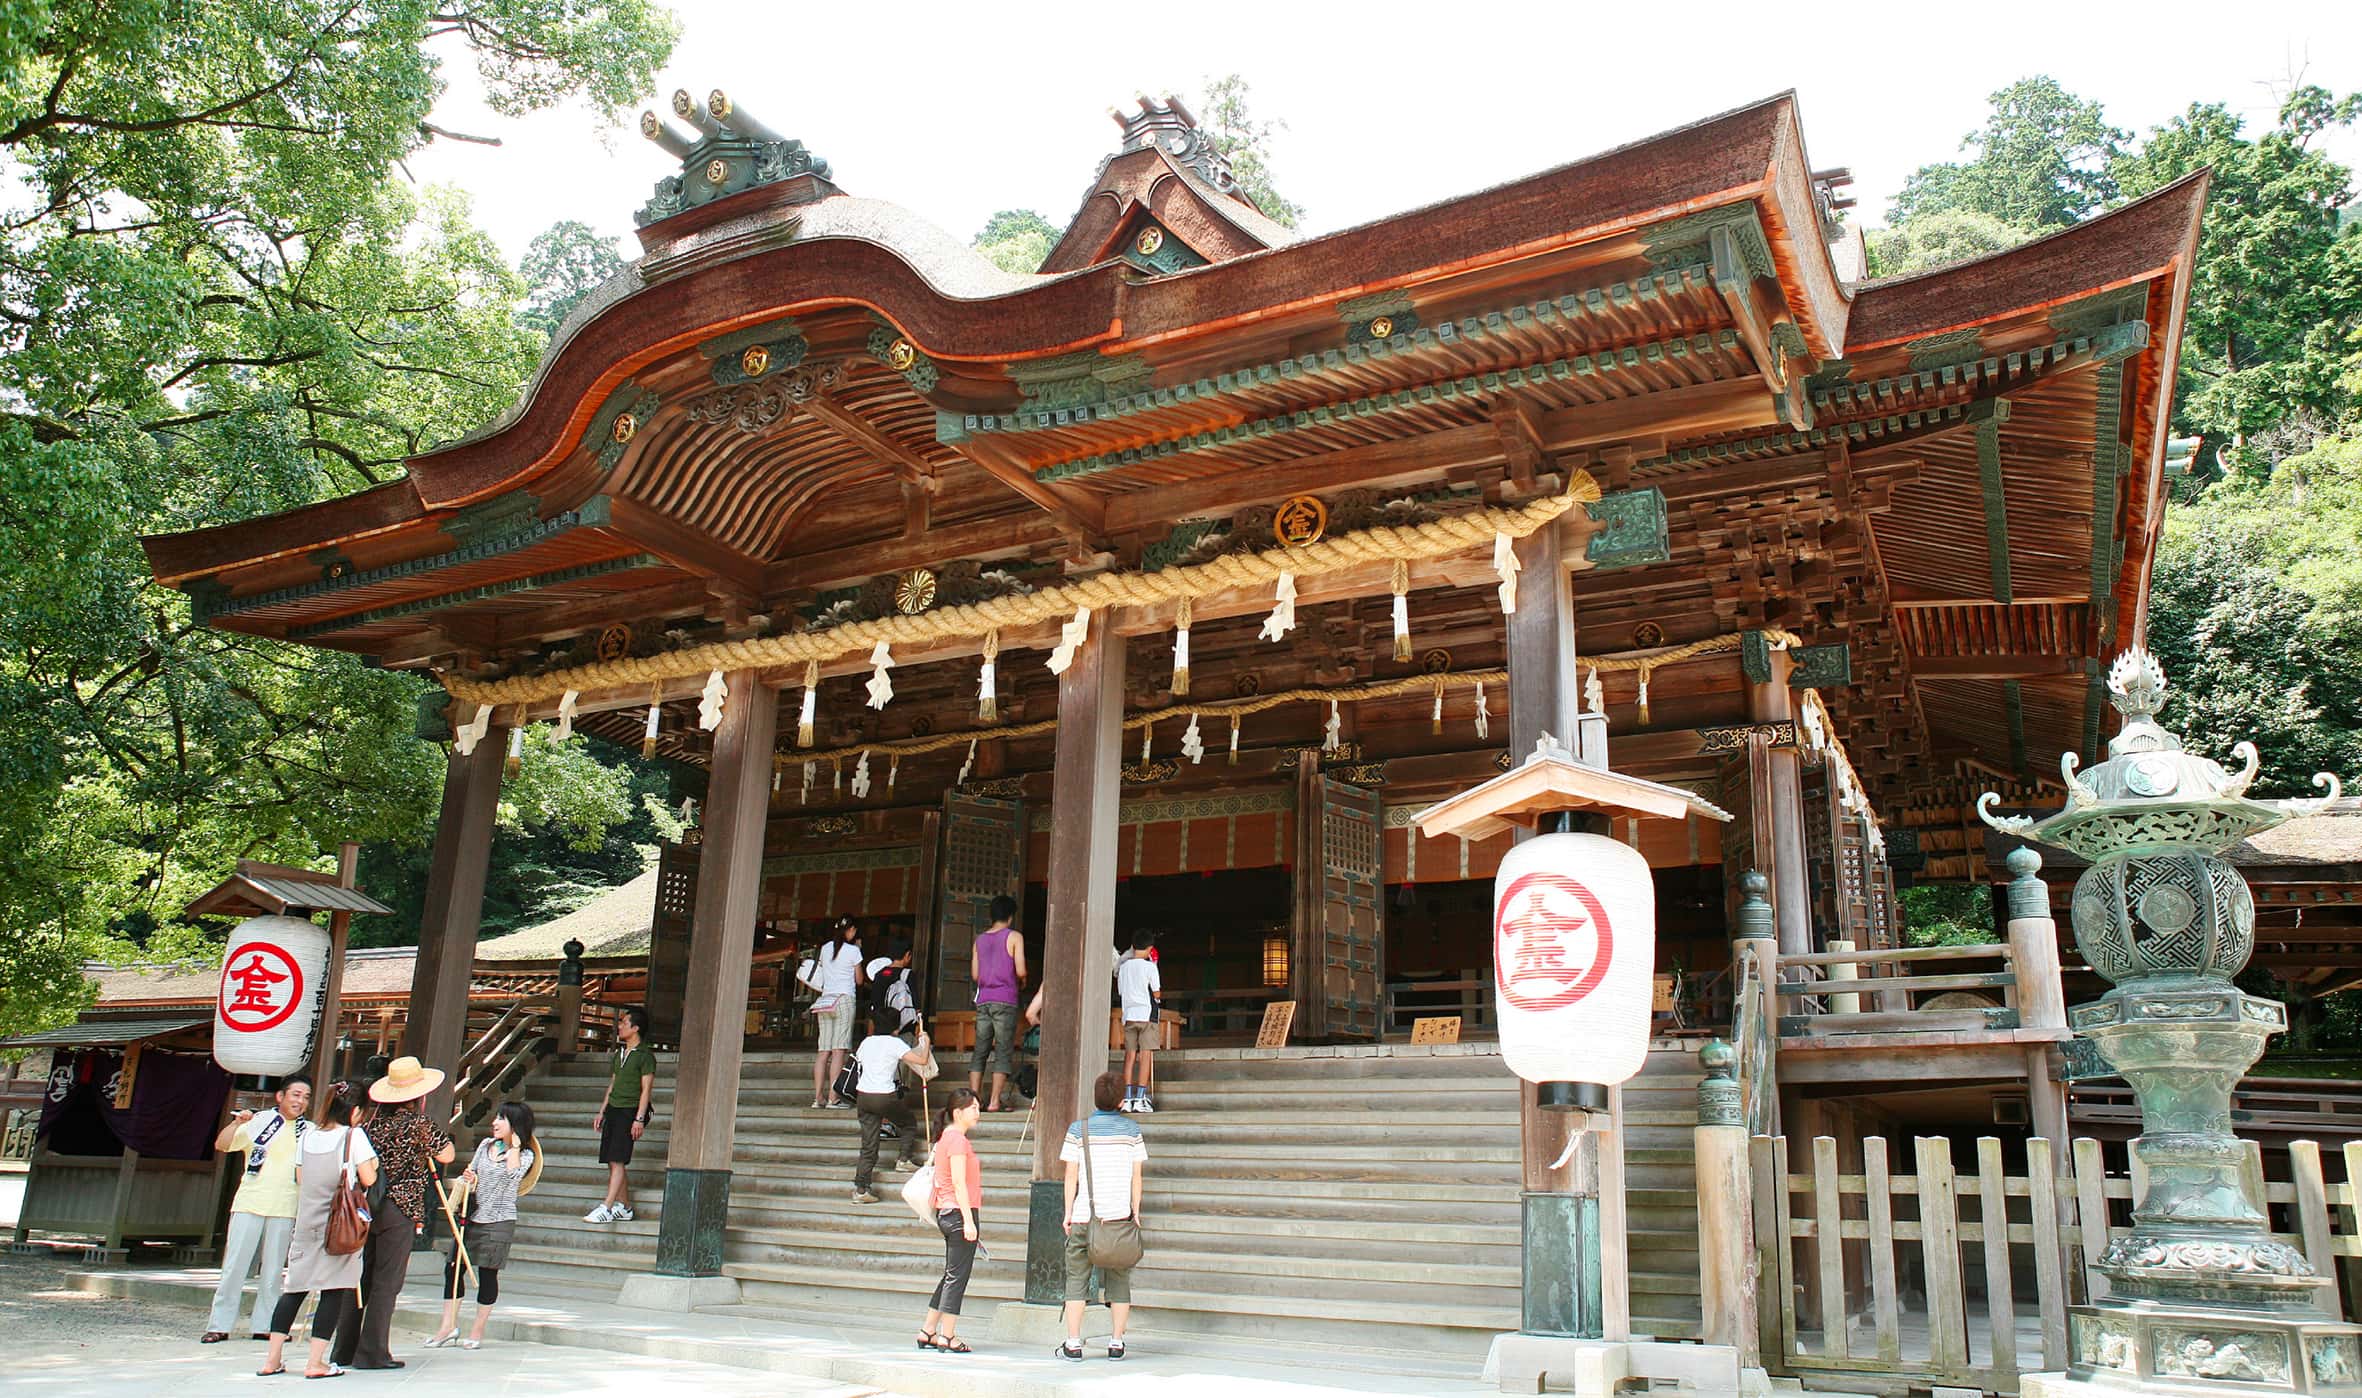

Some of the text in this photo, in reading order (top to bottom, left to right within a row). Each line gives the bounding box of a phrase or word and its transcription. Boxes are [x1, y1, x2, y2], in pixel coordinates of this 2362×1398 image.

[1282, 502, 1317, 541] 金
[1502, 891, 1588, 985] 金
[228, 954, 290, 1016] 金
